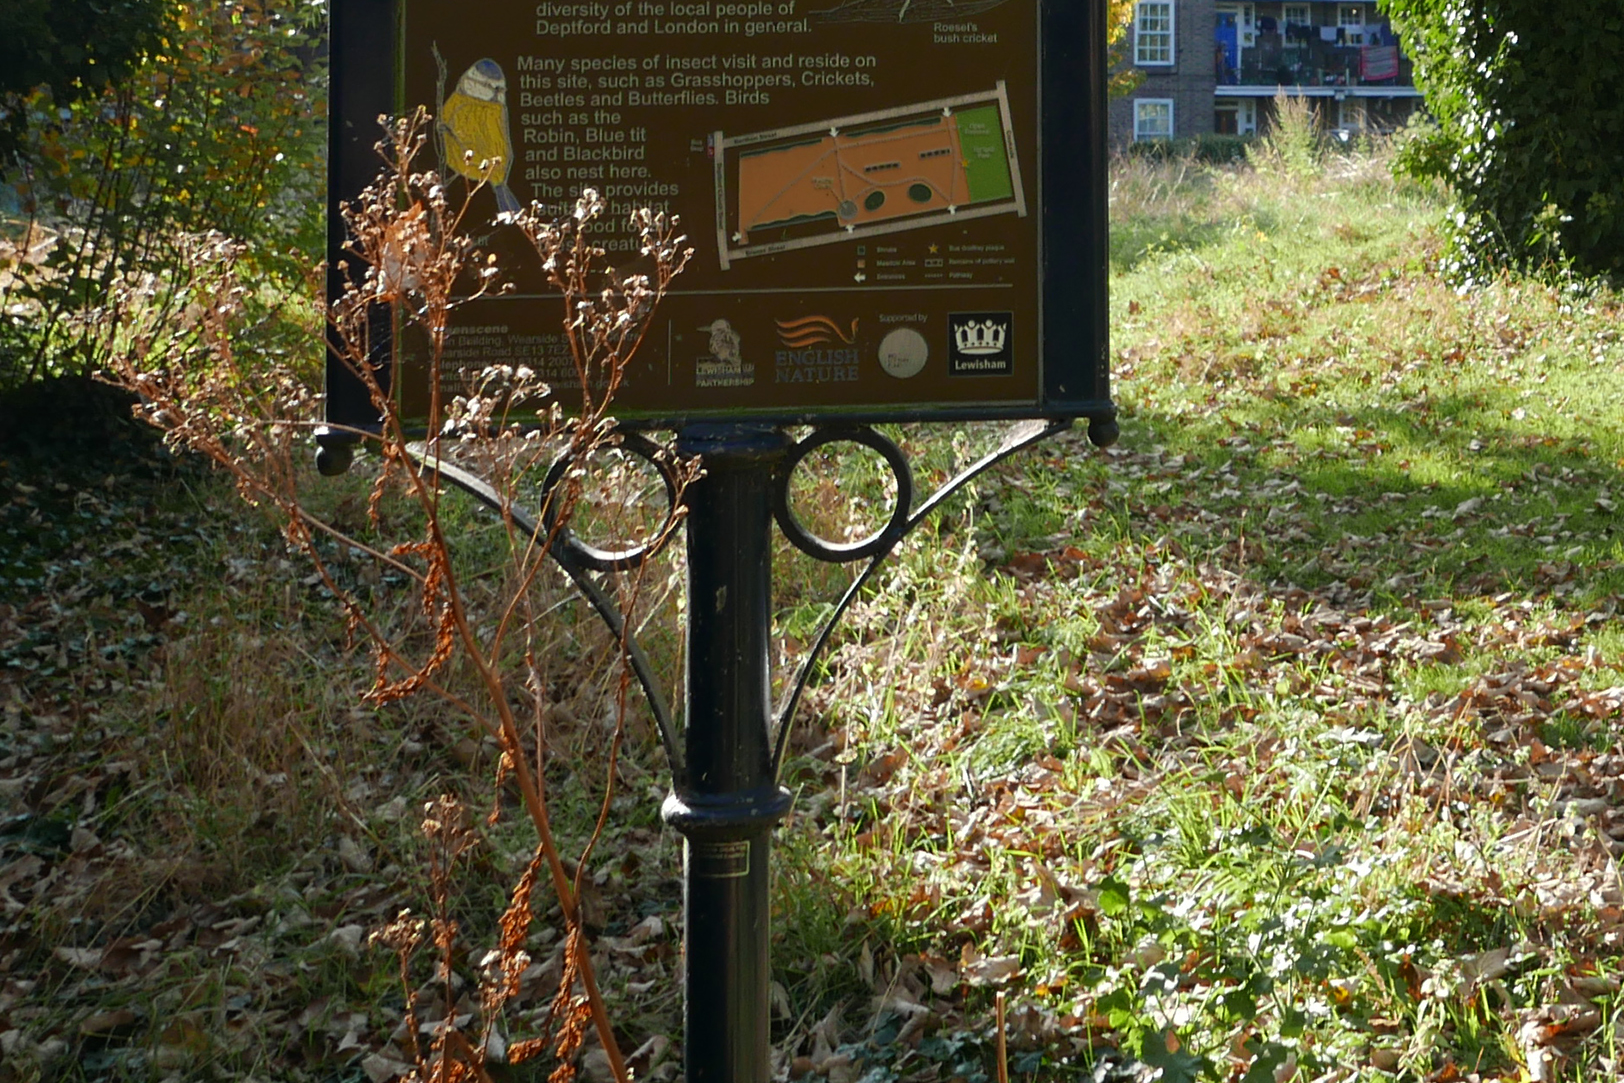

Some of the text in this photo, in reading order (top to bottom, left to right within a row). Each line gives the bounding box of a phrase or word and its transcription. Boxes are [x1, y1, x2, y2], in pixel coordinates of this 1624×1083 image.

[536, 0, 795, 20] diversity of the local people of
[536, 18, 812, 38] Deptford and London in general.
[934, 22, 978, 32] Roesel's
[934, 33, 997, 43] bush cricket
[517, 53, 876, 74] Many species of insect visit and reside on
[520, 70, 874, 92] this site, such as Grasshoppers, Crickets,
[520, 88, 770, 107] Beetles and Butterflies. Birds
[521, 109, 621, 125] such as the
[524, 127, 646, 145] Robin, Blue tit
[525, 145, 644, 162] and Blackbird
[525, 163, 651, 180] also nest here.
[531, 183, 563, 197] The
[606, 181, 679, 199] provides
[879, 313, 927, 323] Supported by
[483, 347, 512, 356] Road
[514, 345, 544, 355] SE13
[775, 348, 861, 365] ENGLISH
[955, 359, 1006, 370] Lewisham
[774, 366, 861, 383] NATURE
